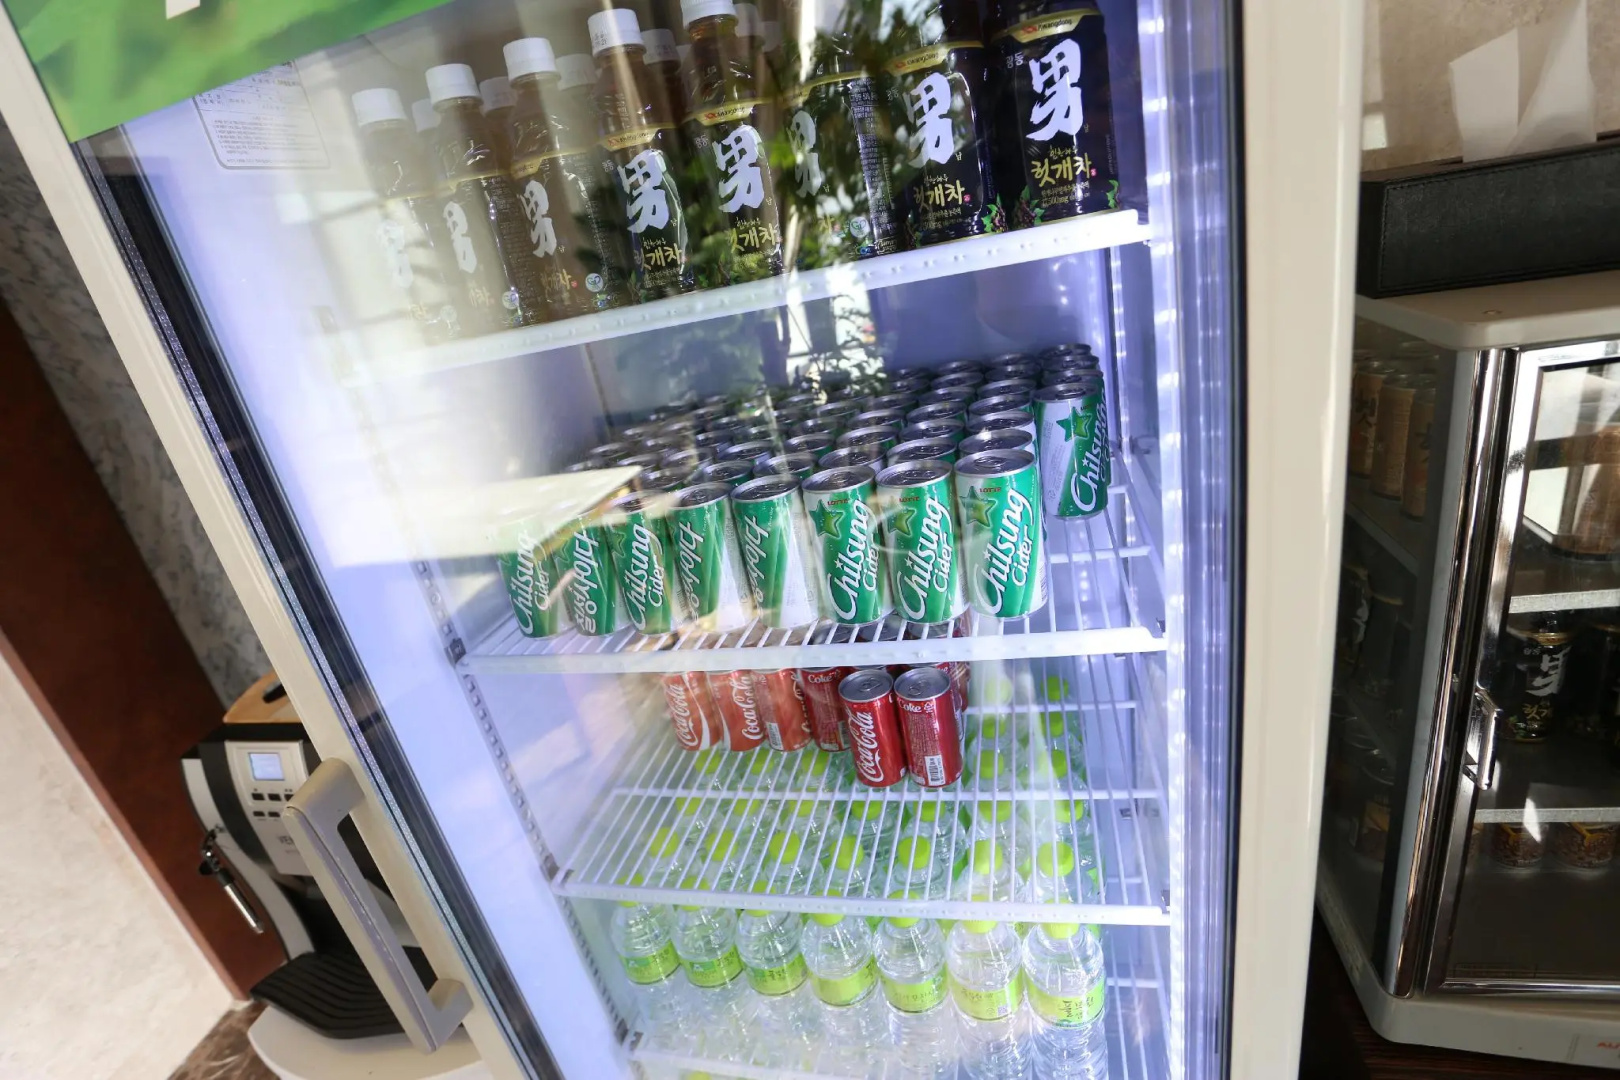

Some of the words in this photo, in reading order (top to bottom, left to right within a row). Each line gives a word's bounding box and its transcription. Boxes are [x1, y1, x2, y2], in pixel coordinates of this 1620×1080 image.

[902, 72, 955, 169] 男
[1026, 38, 1084, 141] 男
[617, 149, 670, 233] 男
[712, 124, 765, 213] 男
[1031, 152, 1092, 188] 헛개차
[622, 523, 663, 631] Chilsung
[827, 500, 879, 620] Chilsung
[862, 533, 879, 592] Cider
[896, 497, 953, 620] Chilsung
[933, 533, 952, 593] Cider
[974, 488, 1034, 614] Chilsung
[1011, 525, 1033, 587] Cider
